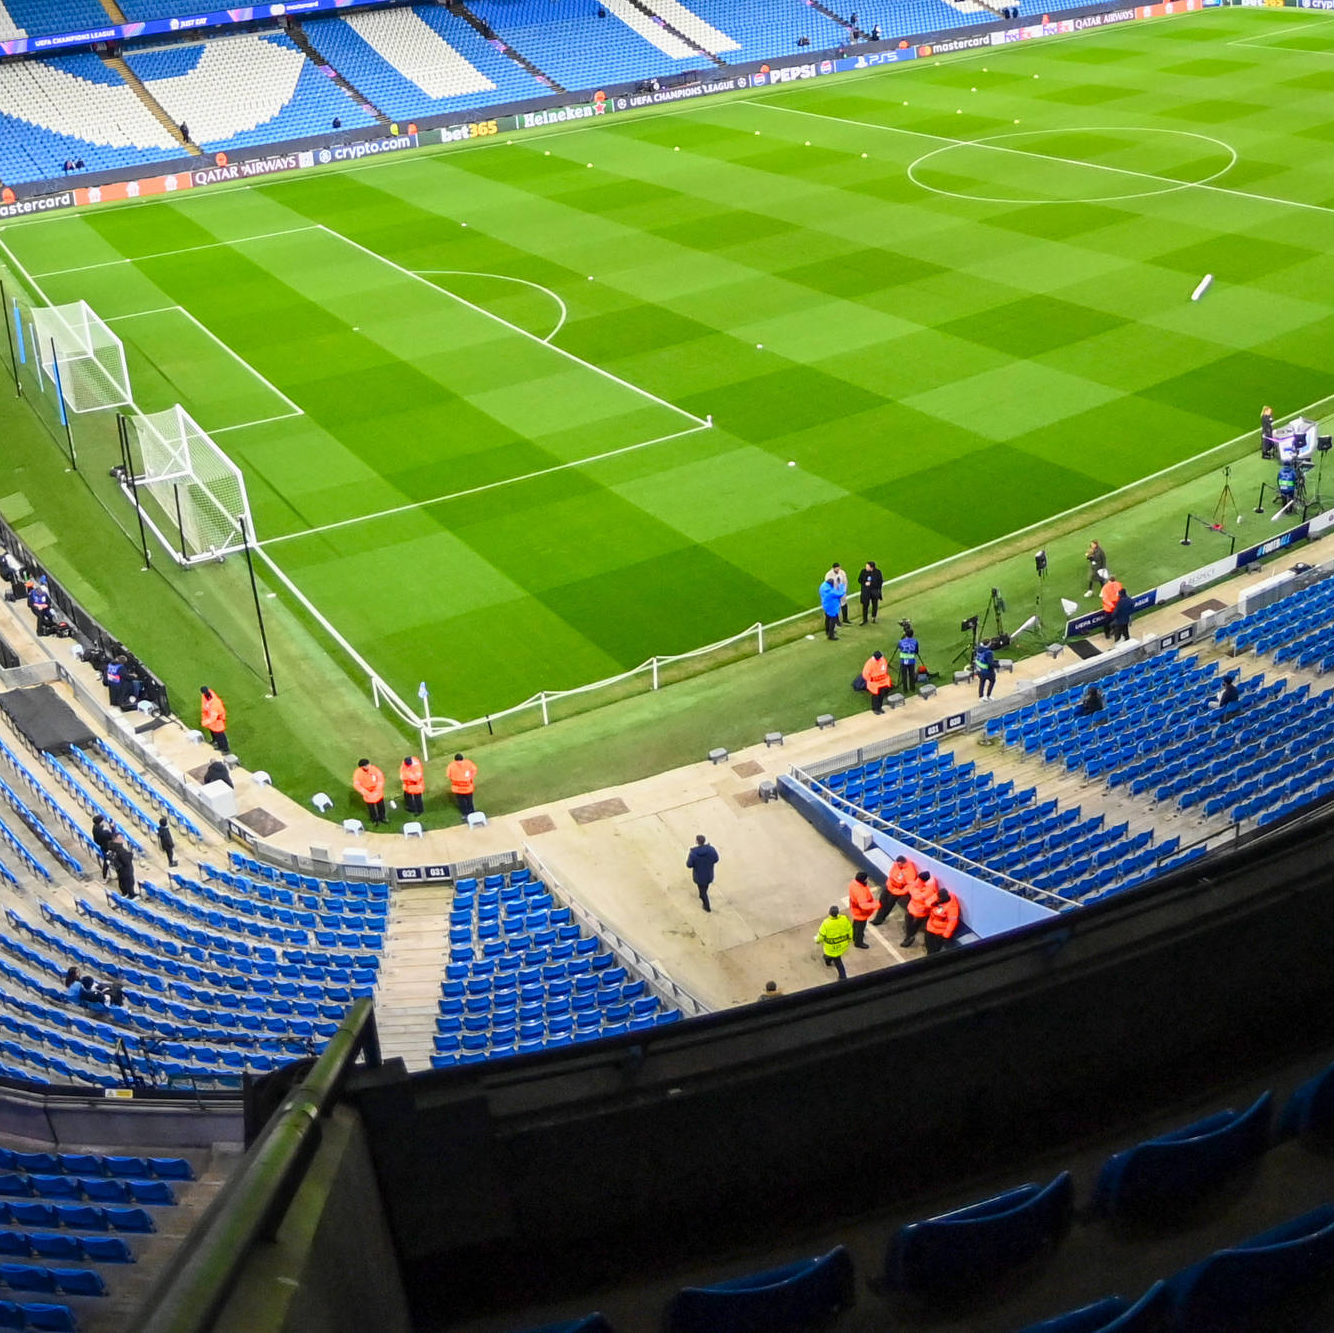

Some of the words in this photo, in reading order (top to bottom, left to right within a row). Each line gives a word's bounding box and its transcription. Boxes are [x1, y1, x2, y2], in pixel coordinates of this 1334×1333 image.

[1075, 16, 1102, 31] QATAR
[1103, 9, 1134, 25] AIRWAYS
[52, 32, 90, 45] CHAMPIONS
[90, 29, 116, 40] LEAGUE
[932, 35, 990, 54] mastercard
[868, 52, 899, 65] PS5
[770, 64, 816, 84] PEPSI
[630, 94, 653, 106] UEFA
[653, 86, 703, 104] CHAMPIONS
[703, 80, 735, 95] LEAGUE
[523, 104, 593, 128] Heineken
[441, 120, 498, 143] bet365
[334, 136, 411, 160] crypto.com
[195, 165, 239, 186] QATAR
[242, 155, 297, 178] AIRWAYS
[1074, 616, 1092, 630] UEFA
[402, 869, 417, 878] 032
[430, 867, 445, 876] 031
